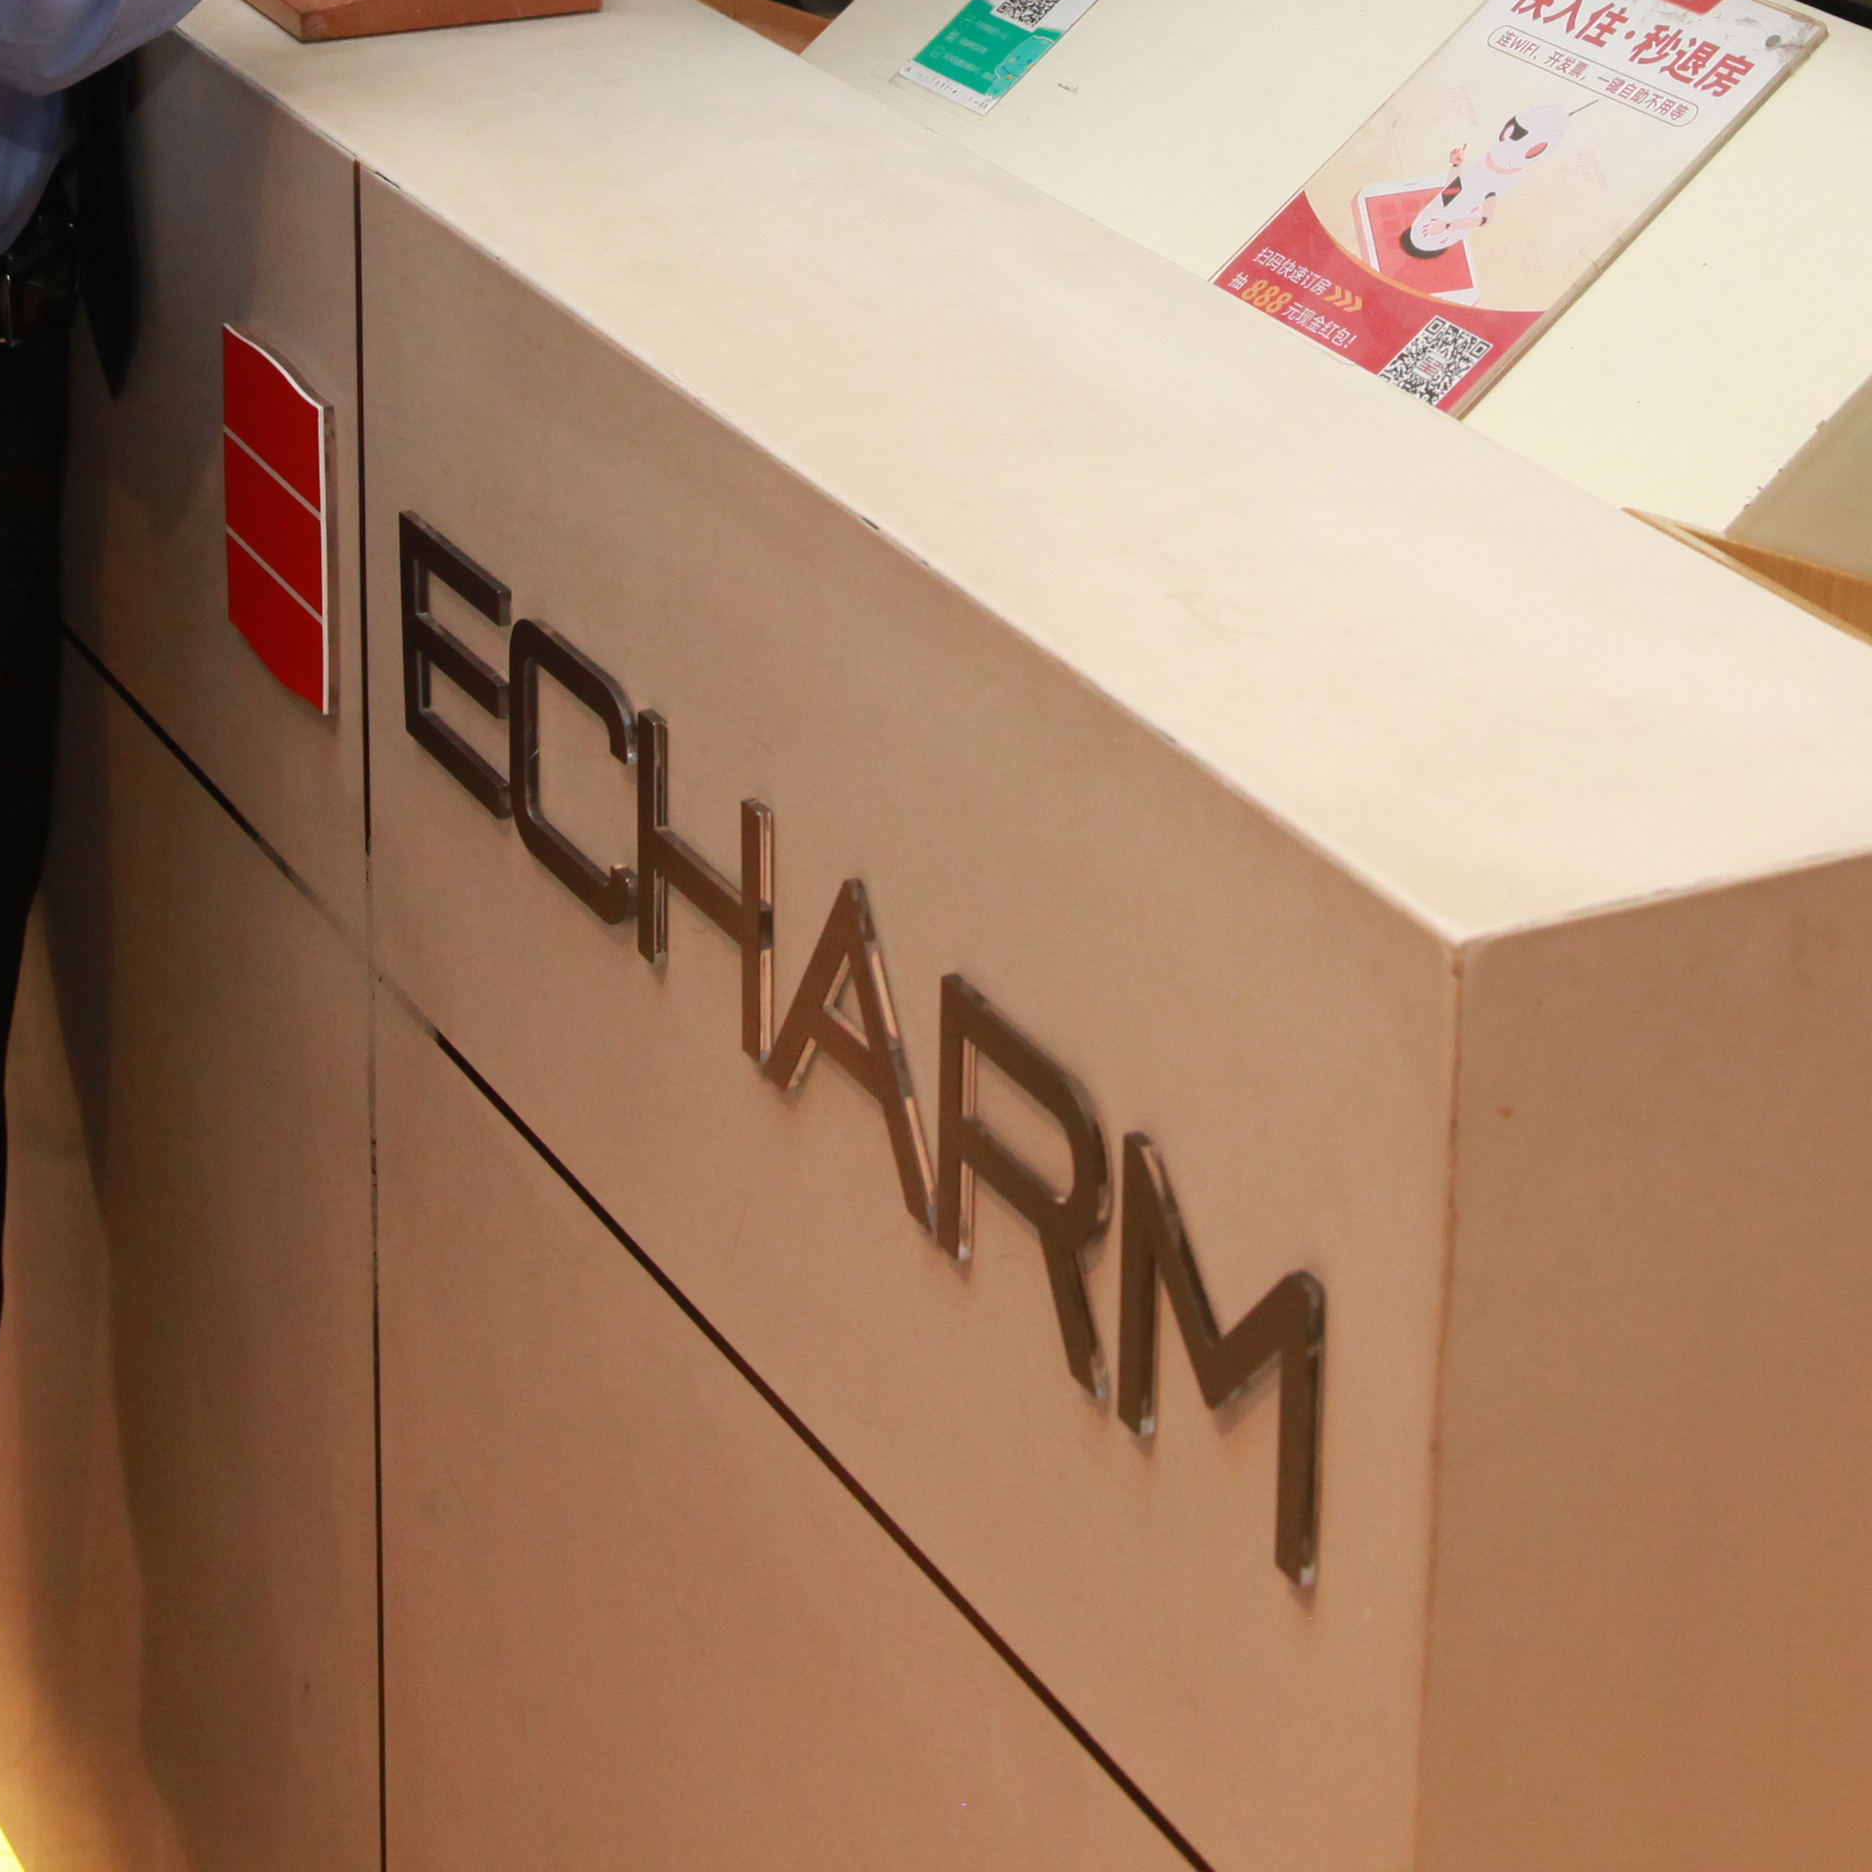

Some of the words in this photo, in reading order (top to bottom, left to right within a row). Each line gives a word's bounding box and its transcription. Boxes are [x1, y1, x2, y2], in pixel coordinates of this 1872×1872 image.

[1252, 246, 1333, 297] 扫码快速订房
[399, 510, 1327, 1588] ECHARM
